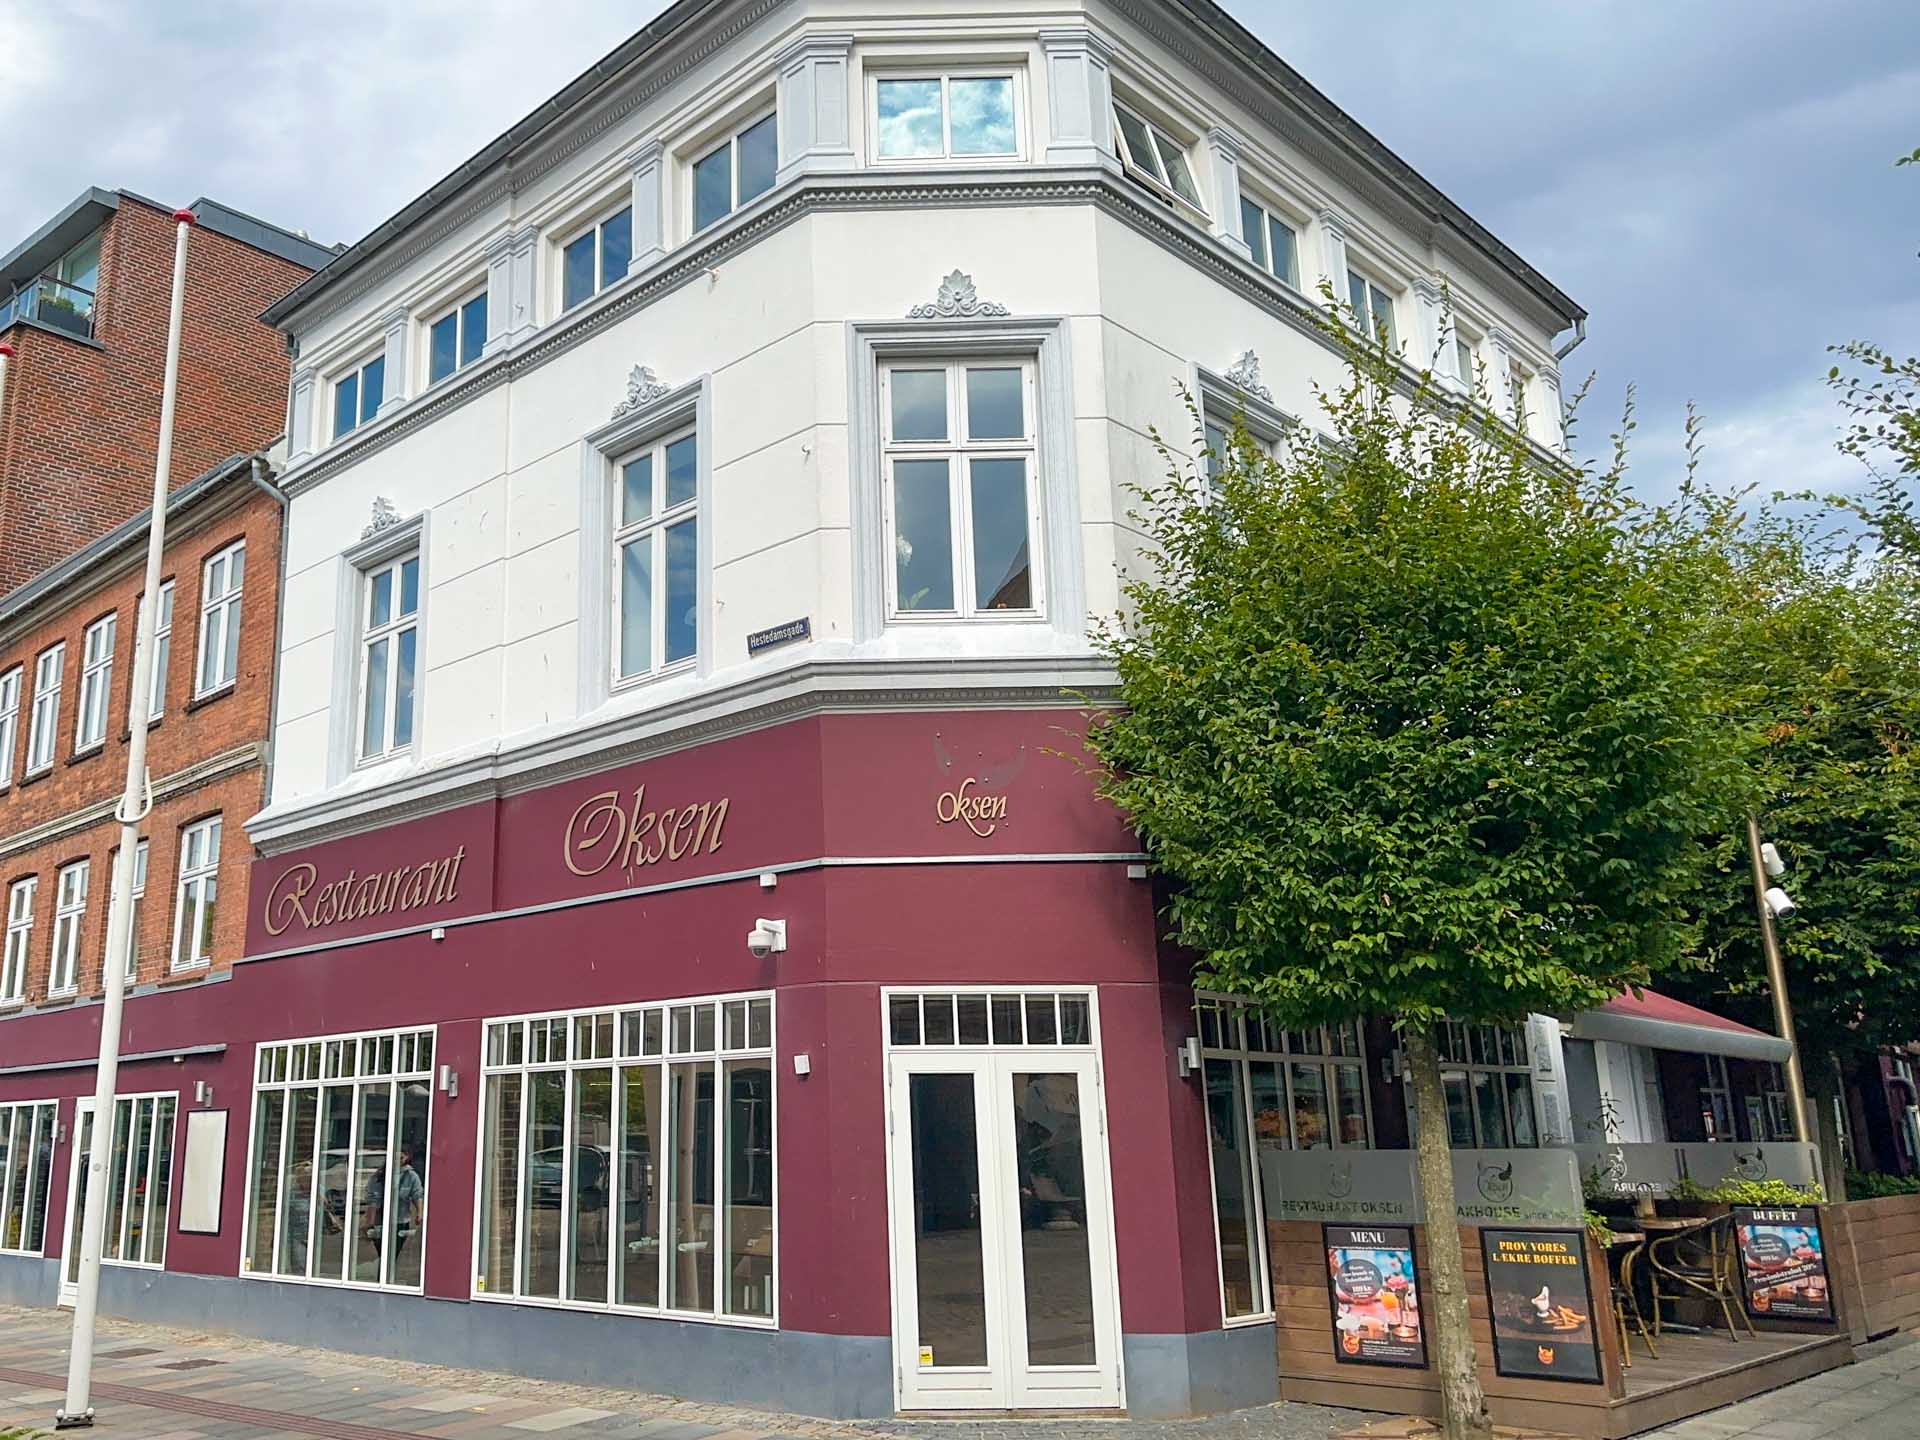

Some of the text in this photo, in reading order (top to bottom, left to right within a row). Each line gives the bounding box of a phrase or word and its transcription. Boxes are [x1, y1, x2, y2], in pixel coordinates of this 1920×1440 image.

[751, 621, 804, 648] Hestedamsgade
[936, 777, 1008, 837] Oksen
[264, 783, 729, 936] Restaurant Oksen
[1361, 1202, 1403, 1214] OKSEN
[1456, 1205, 1521, 1218] AKHOUSE
[1752, 1210, 1798, 1221] BUFFET
[1350, 1231, 1386, 1243] MENU
[1530, 1242, 1568, 1253] VORES
